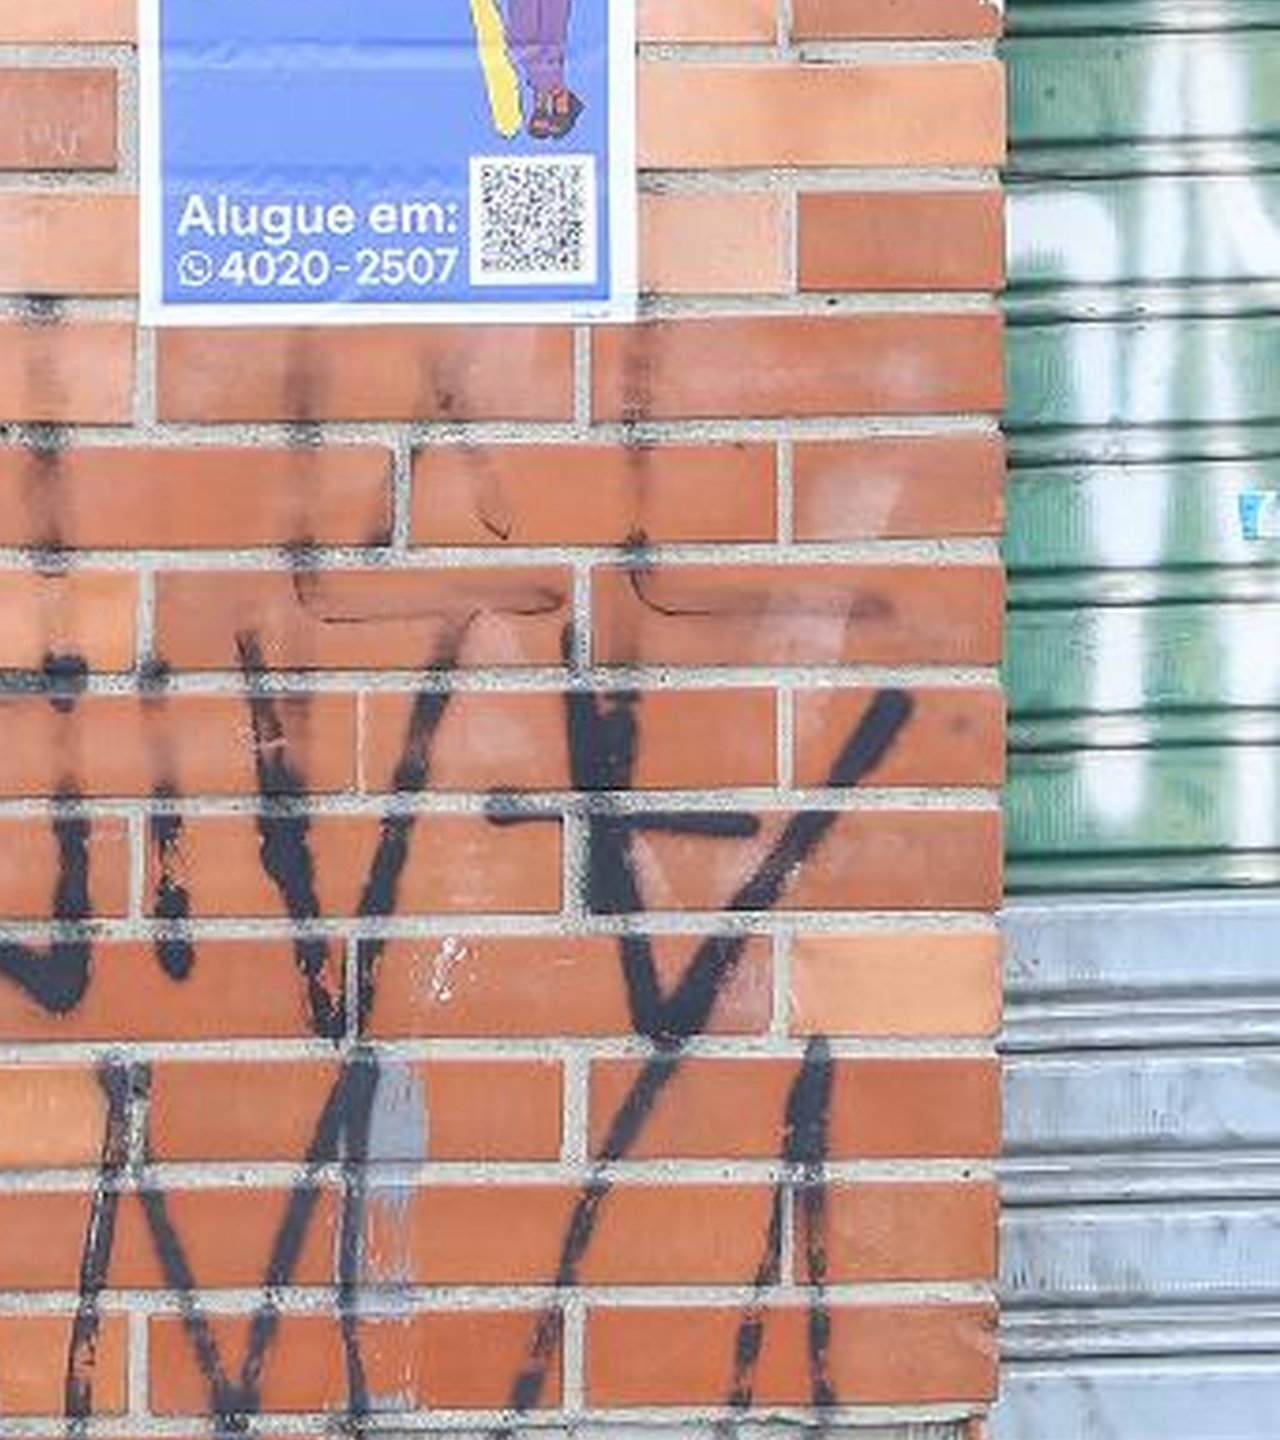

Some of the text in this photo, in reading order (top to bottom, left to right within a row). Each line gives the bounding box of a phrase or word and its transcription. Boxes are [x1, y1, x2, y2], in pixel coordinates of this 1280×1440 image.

[177, 194, 458, 246] Alugue em:
[218, 247, 460, 287] 4020-2507
